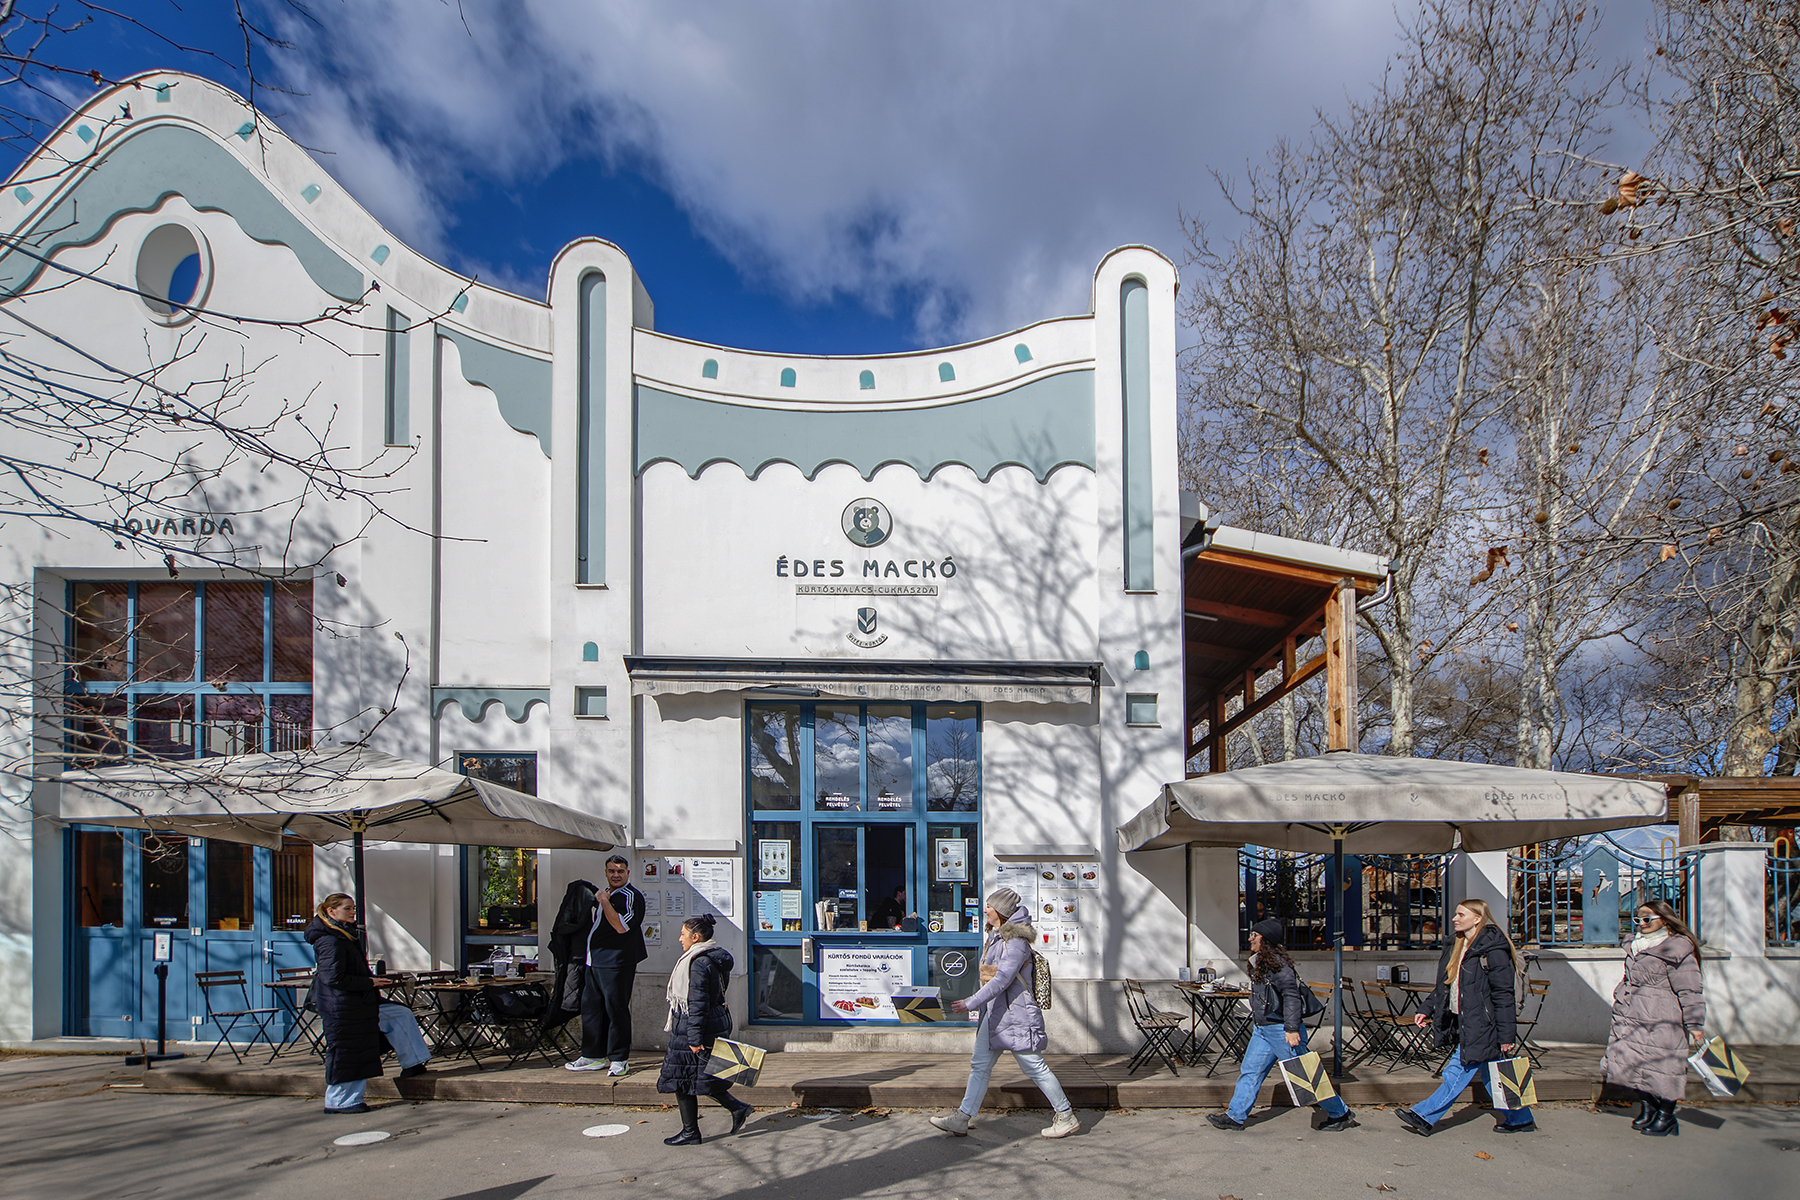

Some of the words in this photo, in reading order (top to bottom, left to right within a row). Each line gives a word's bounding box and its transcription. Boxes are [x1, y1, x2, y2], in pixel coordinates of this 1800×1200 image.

[776, 555, 845, 578] ÉDES
[862, 556, 957, 579] MACKÓ
[913, 684, 942, 692] MACKÓ
[1304, 791, 1346, 801] MACKÓ
[1521, 791, 1563, 800] MACKÓ
